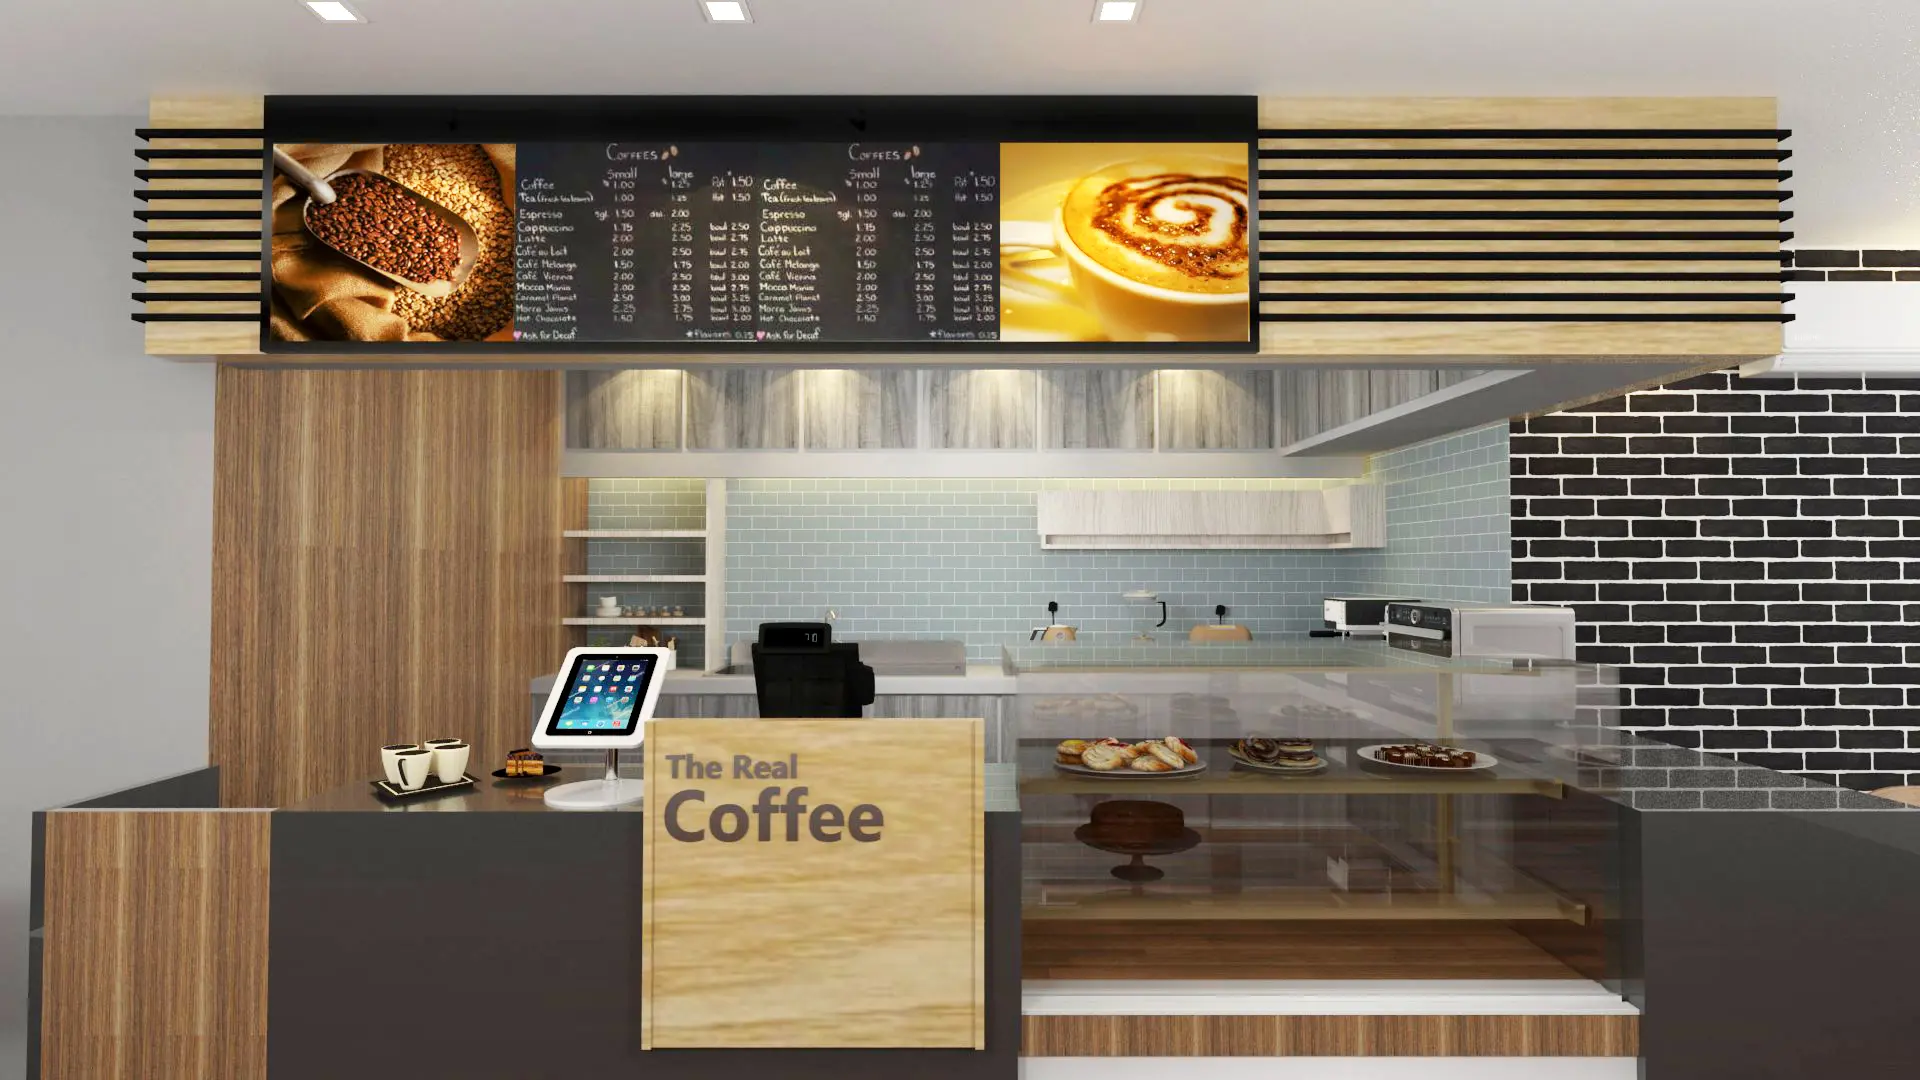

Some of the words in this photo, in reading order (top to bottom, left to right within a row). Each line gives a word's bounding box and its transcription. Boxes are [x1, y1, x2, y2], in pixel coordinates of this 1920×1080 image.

[607, 167, 637, 179] Small
[850, 167, 879, 179] Small
[521, 178, 554, 190] Coffee
[764, 178, 797, 190] Coffee
[732, 193, 750, 202] 1.50
[975, 193, 993, 202] 1.50
[520, 209, 562, 220] Espresso
[616, 209, 634, 218] 1.50
[672, 209, 690, 218] 2.00
[763, 209, 805, 220] Espresso
[858, 209, 877, 218] 1.50
[914, 209, 933, 218] 2.00
[517, 221, 574, 234] Cappuccino
[614, 223, 633, 232] 1.75
[672, 223, 691, 231] 2.25
[731, 222, 750, 231] 2.50
[760, 221, 817, 234] Cappuccino
[856, 223, 875, 232] 1.75
[915, 223, 934, 231] 2.25
[974, 222, 992, 231] 2.50
[612, 234, 633, 242] 2.00
[672, 234, 692, 242] 2.50
[731, 234, 748, 242] 2.75
[855, 234, 876, 242] 2.00
[915, 234, 935, 242] 2.50
[974, 234, 991, 242] 2.75
[516, 245, 537, 256] Café
[613, 247, 634, 256] 2.00
[672, 248, 691, 256] 2.50
[759, 245, 780, 256] Café
[856, 247, 876, 256] 2.00
[915, 248, 934, 256] 2.50
[517, 259, 539, 268] Café
[614, 260, 634, 269] 1.50
[673, 261, 692, 269] 1.75
[731, 261, 750, 269] 2.00
[760, 259, 782, 268] Café
[857, 260, 877, 269] 1.50
[916, 261, 935, 269] 1.75
[974, 261, 992, 269] 2.00
[516, 271, 537, 280] Café
[613, 272, 634, 280] 2.00
[672, 273, 692, 281] 2.50
[759, 271, 780, 280] Café
[856, 272, 877, 280] 2.00
[915, 273, 935, 281] 2.50
[516, 282, 544, 291] Mocca
[759, 282, 787, 291] Mocca
[516, 293, 549, 301] Caramel
[613, 294, 634, 302] 2.50
[672, 294, 691, 302] 3.00
[759, 293, 792, 301] Caramel
[856, 294, 877, 302] 2.50
[915, 294, 934, 302] 3.00
[535, 314, 576, 322] Chocolate
[779, 314, 820, 322] Chocolate
[522, 332, 538, 340] Ask
[766, 332, 781, 340] Ask
[665, 753, 723, 779] The
[733, 753, 797, 779] Real
[664, 786, 884, 842] Coffee
